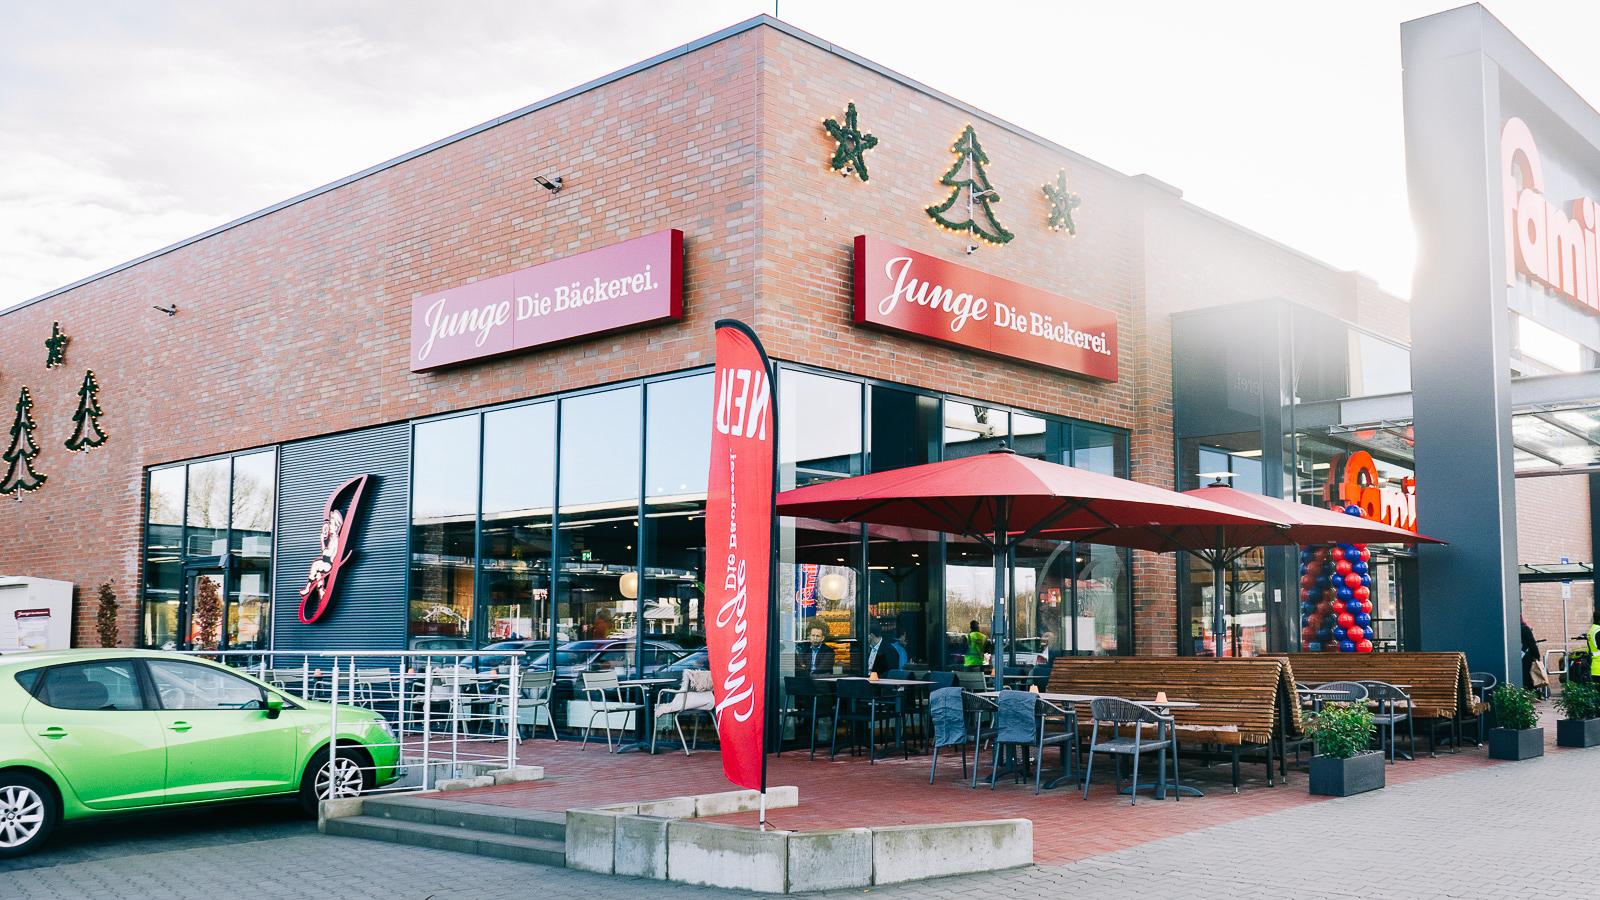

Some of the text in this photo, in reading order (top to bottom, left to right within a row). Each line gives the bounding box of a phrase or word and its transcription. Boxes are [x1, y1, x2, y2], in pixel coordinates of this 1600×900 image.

[418, 264, 659, 361] Junge Die Bäckerei.
[878, 256, 1112, 356] Junge Die Bäckerei.
